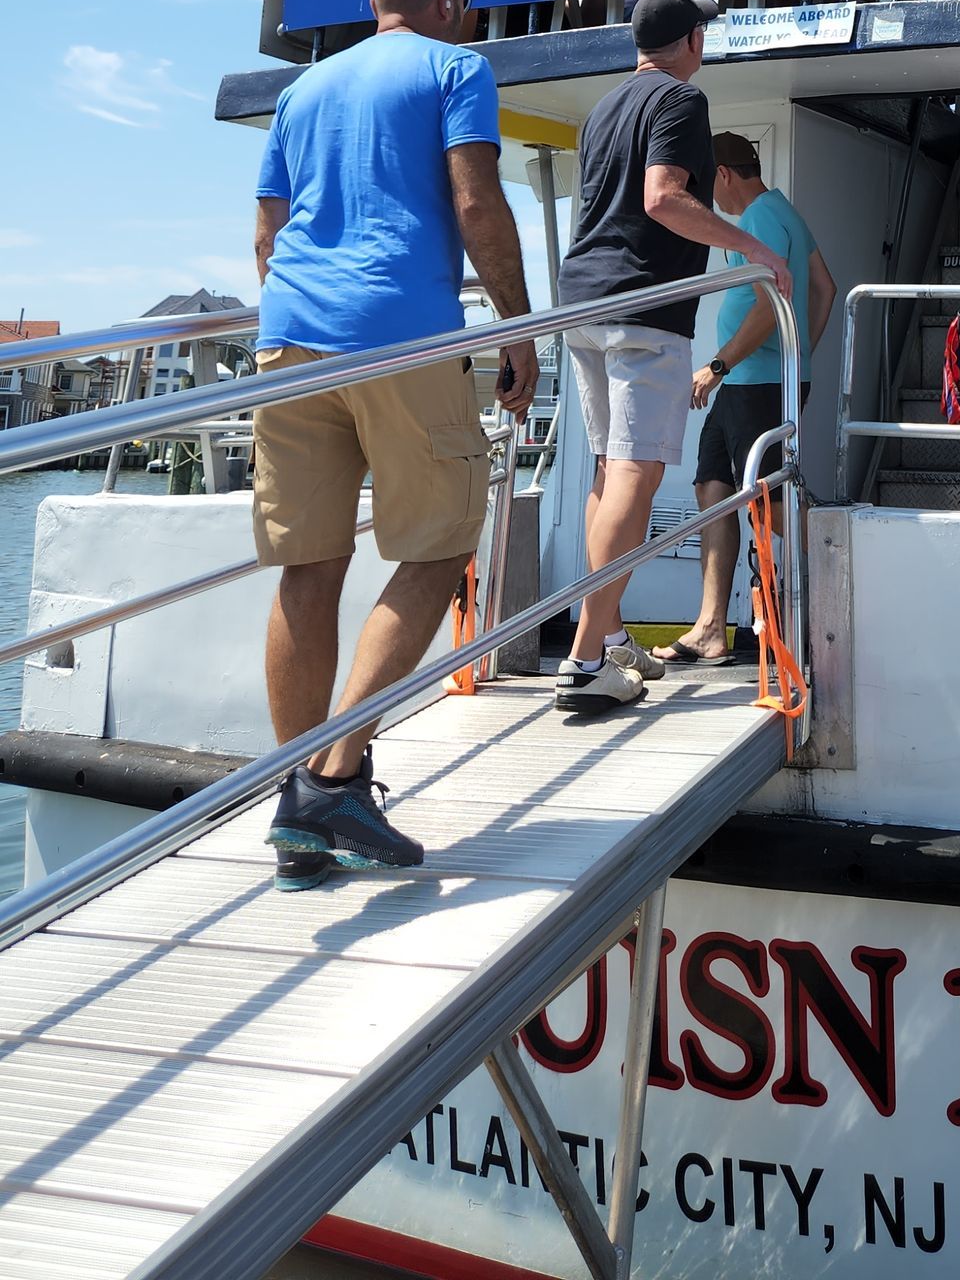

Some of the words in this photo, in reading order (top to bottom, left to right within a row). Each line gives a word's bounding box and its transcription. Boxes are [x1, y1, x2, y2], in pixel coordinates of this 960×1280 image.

[728, 35, 771, 48] WATCH
[731, 11, 795, 26] WELCOME
[798, 6, 850, 22] ABOARD
[512, 927, 907, 1118] UISN
[674, 1151, 836, 1255] CITY,
[864, 1173, 945, 1254] NJ
